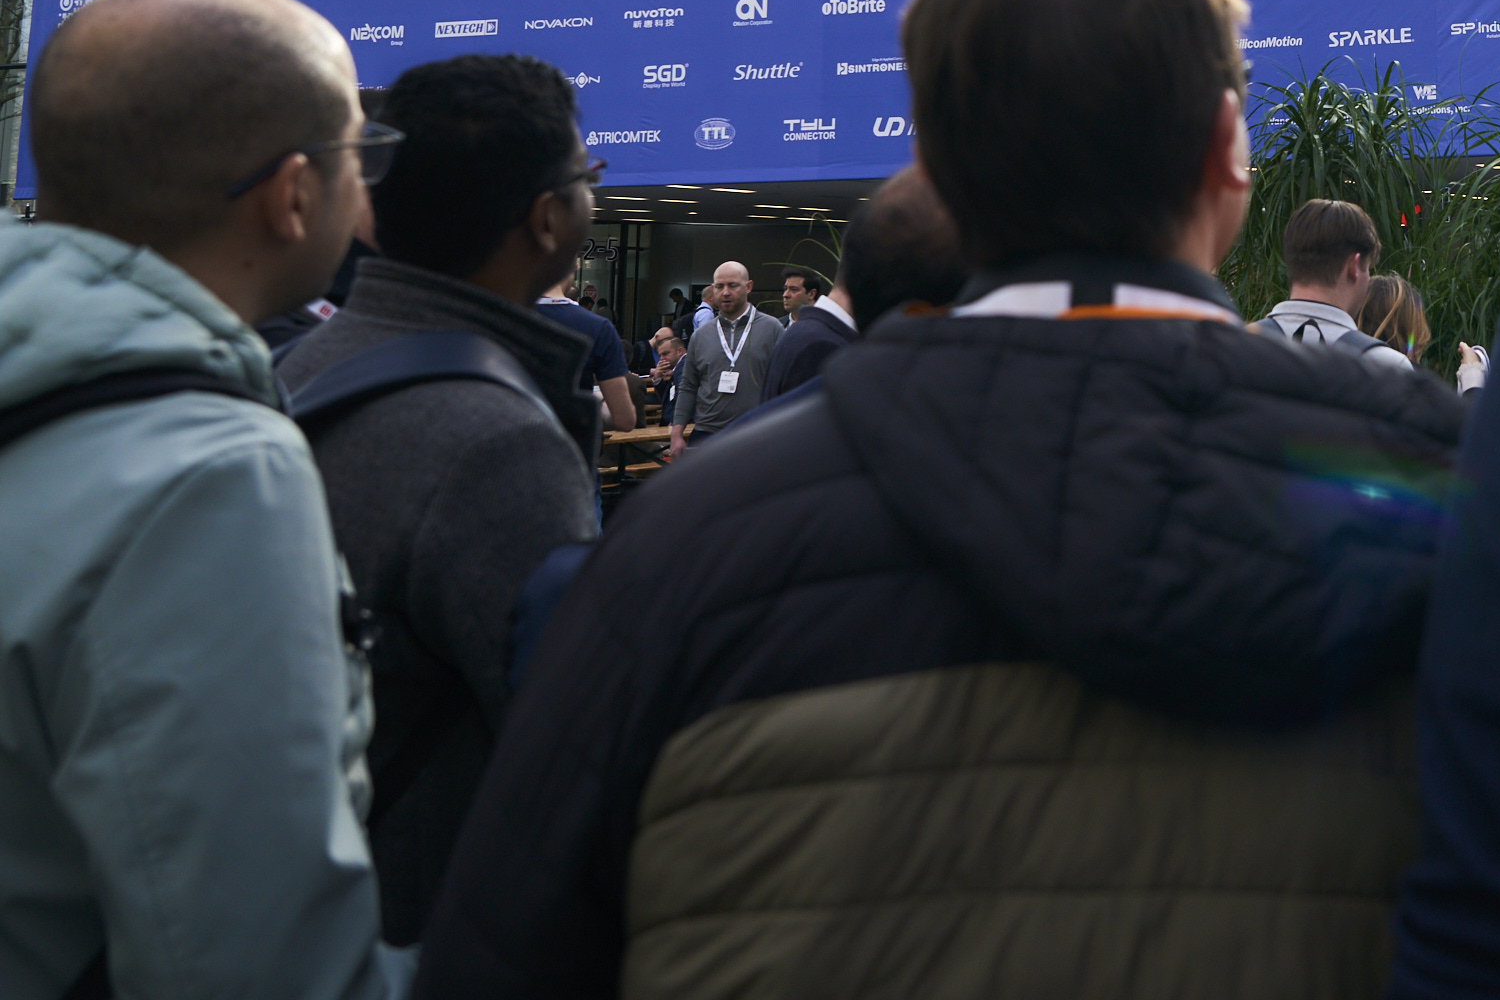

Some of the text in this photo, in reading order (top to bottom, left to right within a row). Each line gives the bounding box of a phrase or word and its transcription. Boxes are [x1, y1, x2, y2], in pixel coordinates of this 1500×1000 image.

[437, 23, 484, 35] NEXTECH
[525, 18, 593, 29] NOVAKON
[1328, 27, 1412, 48] SPARKLE
[644, 63, 687, 84] SGD
[733, 62, 801, 81] Shuttle
[598, 130, 661, 144] TRICOMTEK
[701, 126, 730, 141] TTL
[783, 131, 836, 141] CONNECTOR
